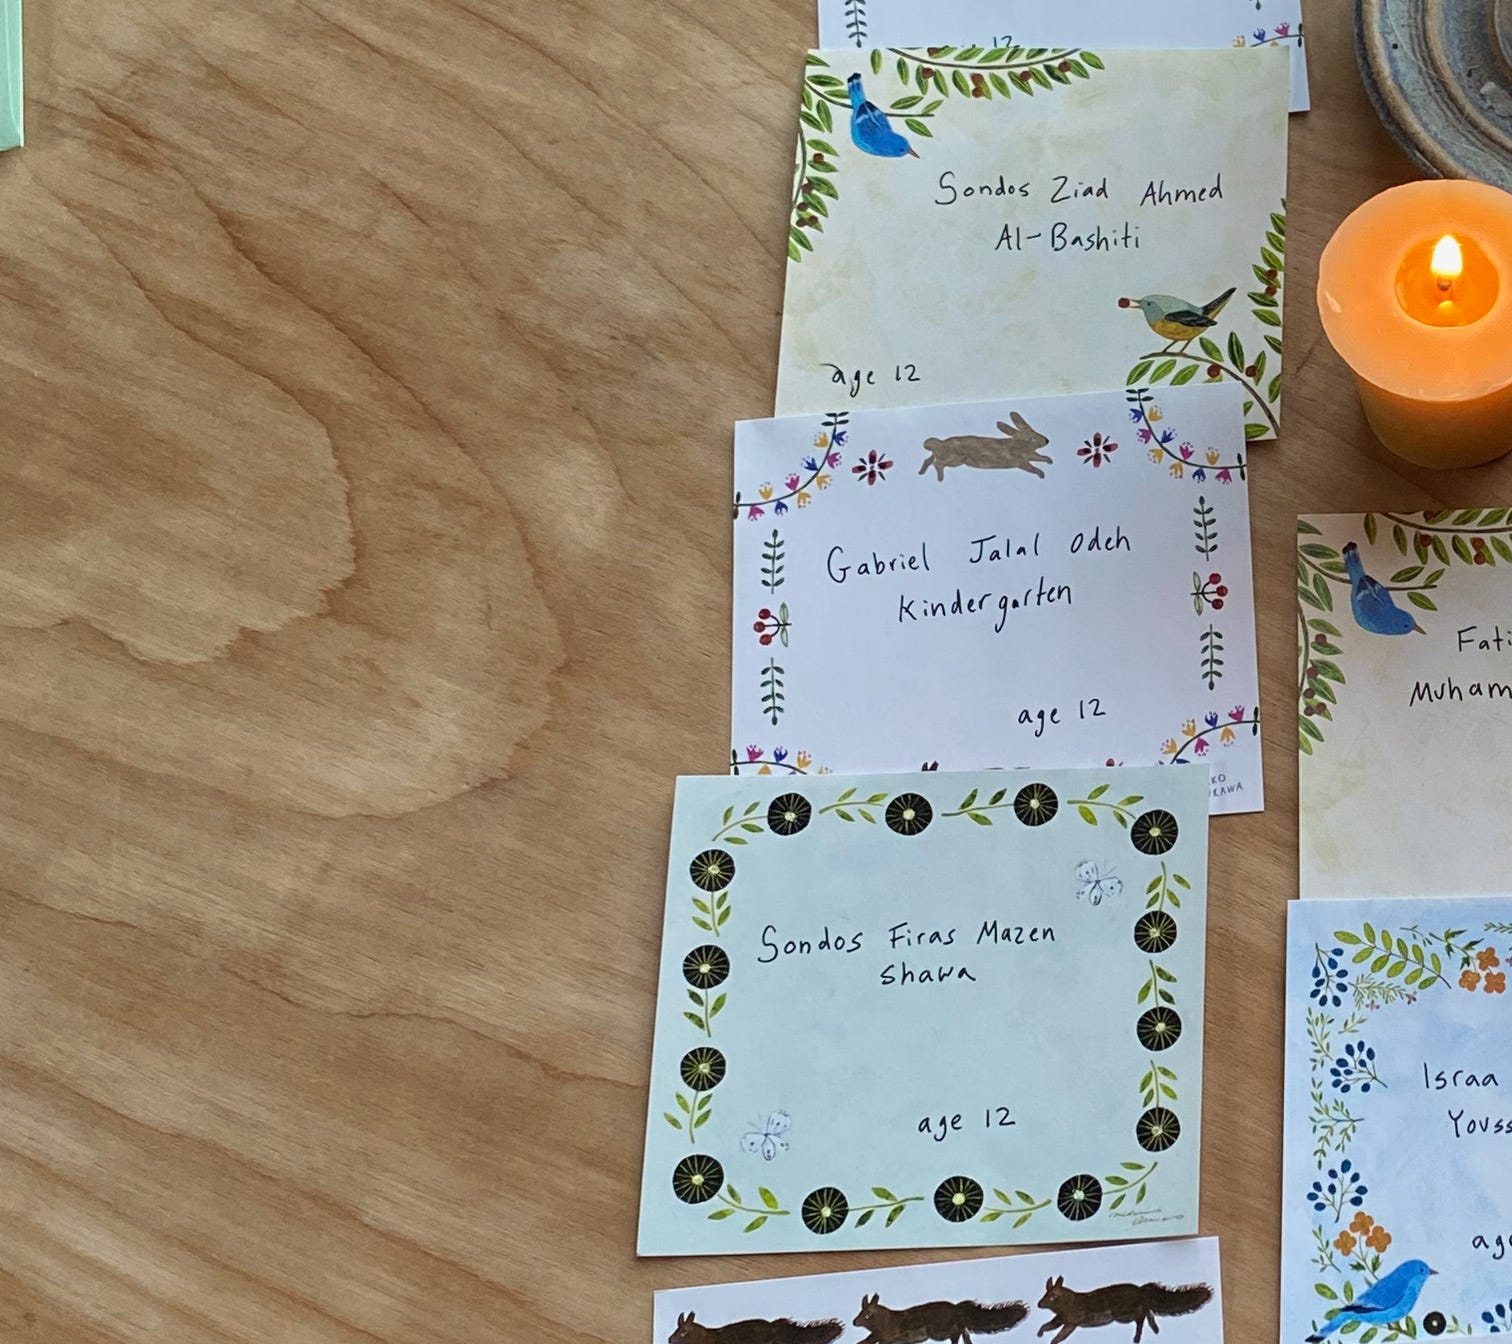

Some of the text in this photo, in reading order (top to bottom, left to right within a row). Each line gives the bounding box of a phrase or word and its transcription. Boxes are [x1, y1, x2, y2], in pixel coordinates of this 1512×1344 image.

[934, 170, 1224, 207] Sondos Ziad Ahmed
[994, 221, 1140, 252] Al-Bashiti
[818, 363, 921, 398] age 12
[826, 525, 1131, 584] Gabriel Jalal Odeh
[898, 575, 1072, 634] Kindergarten
[1017, 698, 1107, 738] age 12
[756, 919, 1056, 964] Sondos Firas Mazen
[1423, 1061, 1499, 1091] Israa
[917, 1106, 1017, 1143] age 12
